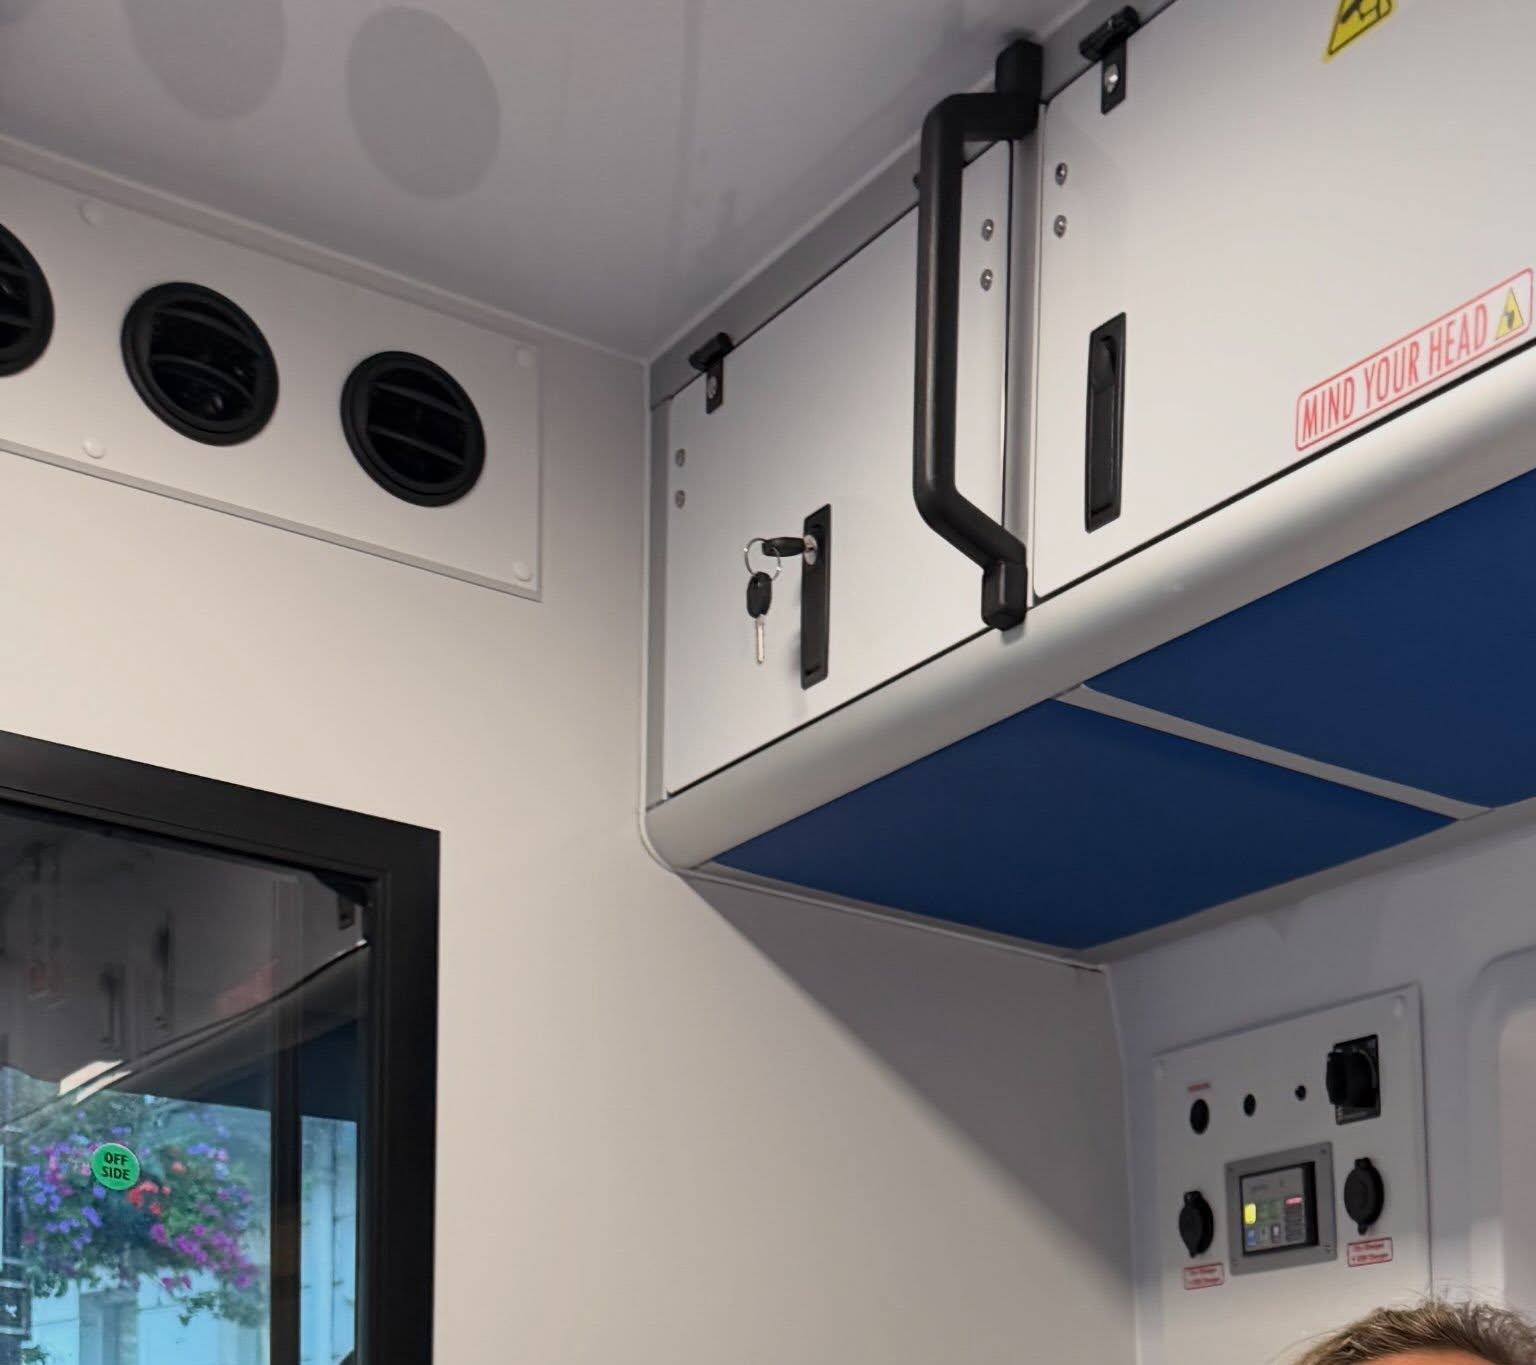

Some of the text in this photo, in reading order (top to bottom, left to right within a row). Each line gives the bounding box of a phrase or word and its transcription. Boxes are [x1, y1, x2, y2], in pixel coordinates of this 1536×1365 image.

[1302, 303, 1488, 442] MIND YOUR HEAD
[103, 1151, 129, 1166] OFF
[102, 1165, 131, 1181] SIDE
